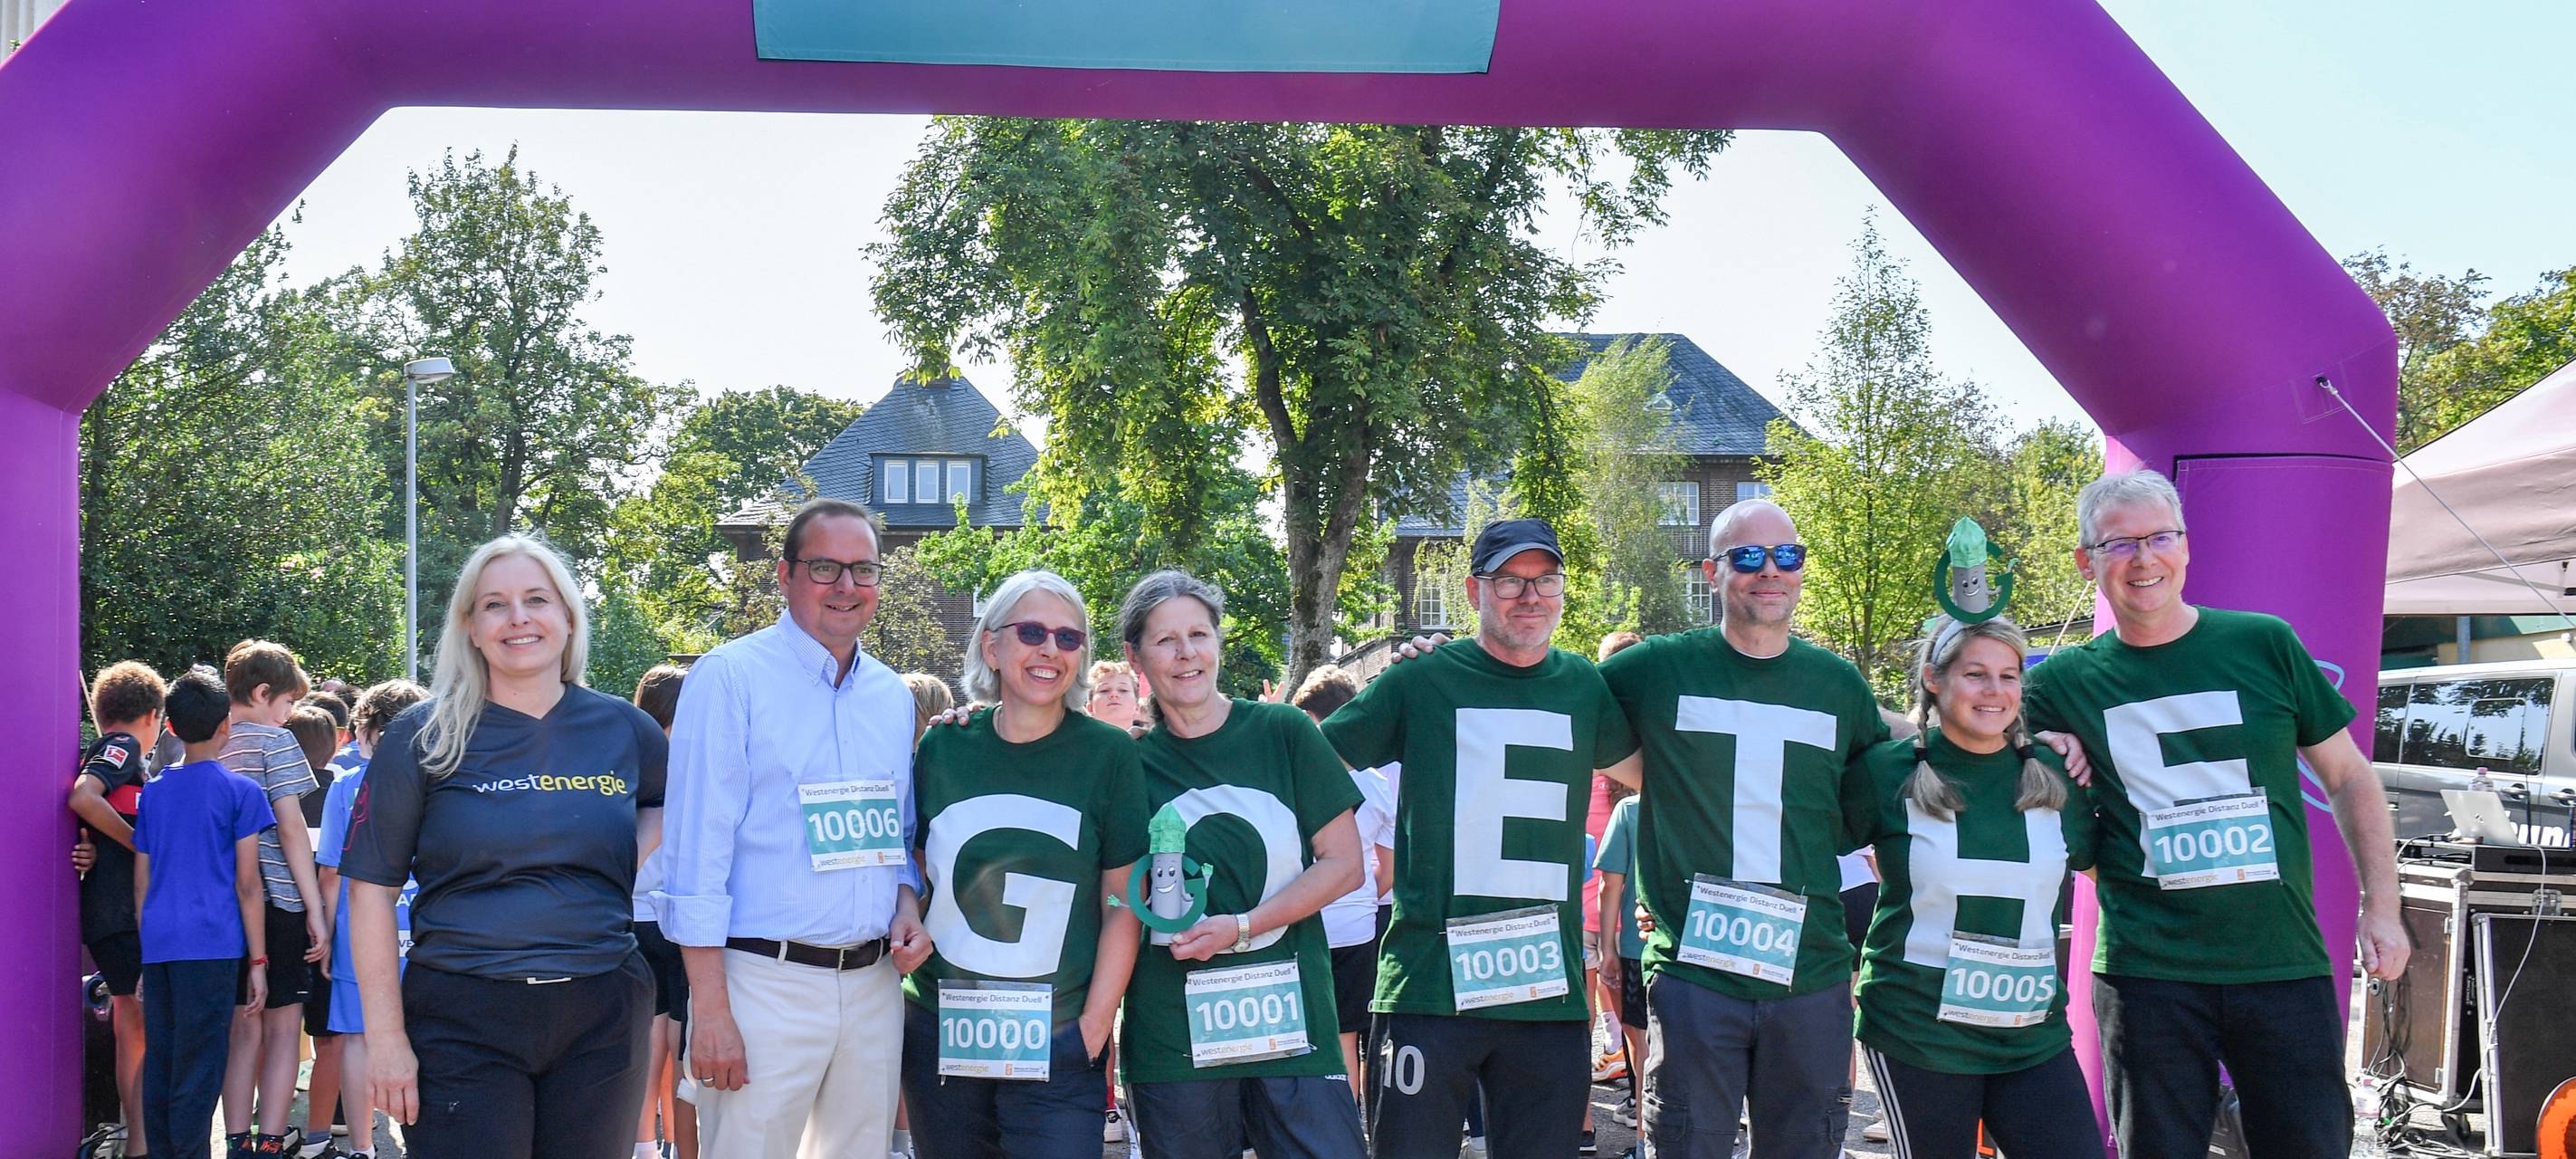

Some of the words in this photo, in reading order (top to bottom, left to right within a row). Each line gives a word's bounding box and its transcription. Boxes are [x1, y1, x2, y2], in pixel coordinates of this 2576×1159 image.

[472, 771, 627, 796] westenergie
[851, 785, 874, 793] Distanz
[874, 784, 890, 792] Duell
[1674, 694, 1837, 884] T
[1454, 708, 1573, 901] E
[2155, 808, 2207, 821] Westenergie
[2209, 804, 2240, 813] Distanz
[808, 808, 900, 842] 10006
[2155, 823, 2272, 864] 10002
[926, 793, 1082, 977] G
[1700, 886, 1748, 903] Westenergie
[1750, 896, 1778, 909] Distanz
[1779, 903, 1798, 914] Duell
[1903, 797, 2069, 969] H
[1455, 925, 1503, 937] Westenergie
[1505, 923, 1533, 932] Distanz
[1534, 918, 1550, 927] Duell
[1691, 909, 1795, 957] 10004
[1455, 940, 1560, 981] 10003
[1958, 943, 2010, 959] Westenergie
[1193, 975, 1243, 986] Westenergie
[1245, 972, 1274, 981] Distanz
[1274, 968, 1291, 977] Duell
[1951, 967, 2055, 1002] 10005
[945, 992, 988, 1003] Westenergie
[990, 994, 1020, 1002] Distanz
[1022, 995, 1042, 1003] Duell
[1196, 991, 1299, 1031] 10001
[942, 1018, 1046, 1049] 10000
[1380, 1039, 1426, 1096] 10
